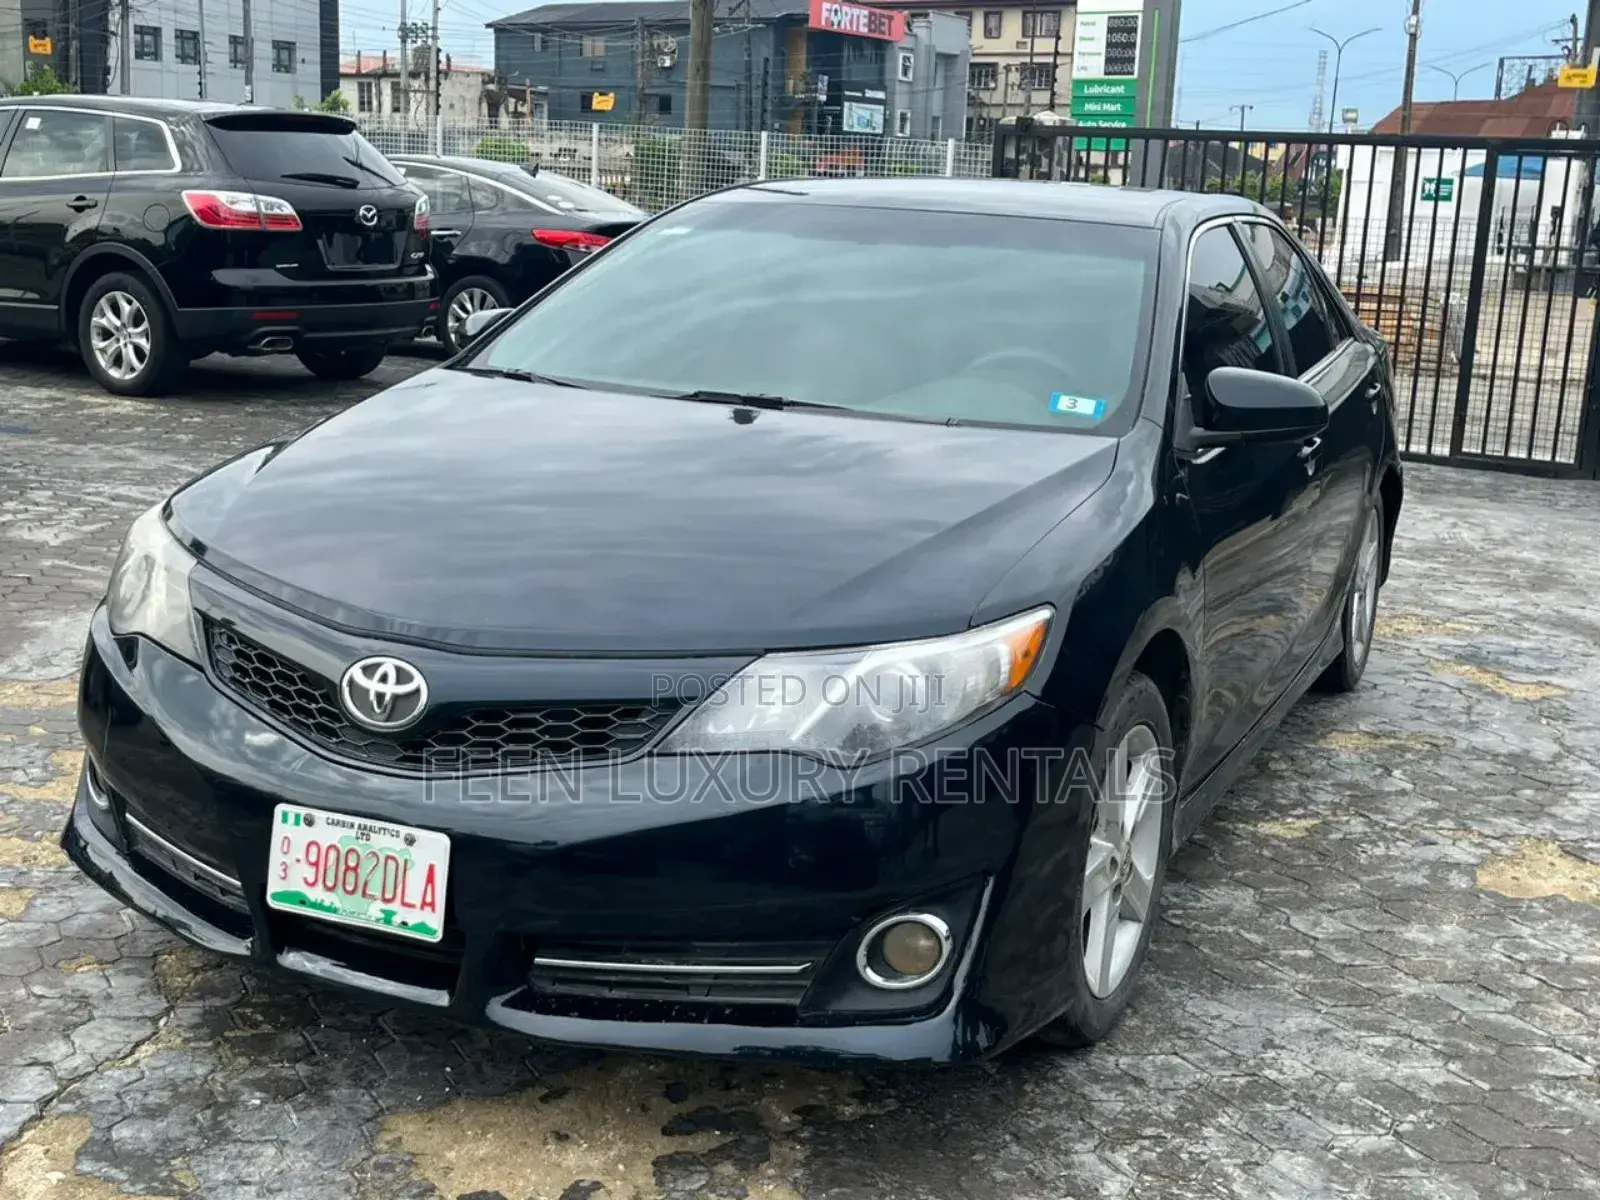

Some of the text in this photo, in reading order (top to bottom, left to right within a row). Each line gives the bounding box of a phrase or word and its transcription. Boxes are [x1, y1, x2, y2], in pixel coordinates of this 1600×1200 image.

[821, 1, 894, 36] FORTEBET
[1083, 84, 1125, 94] Lubricant
[1084, 102, 1122, 111] Mini Mart
[1066, 398, 1078, 410] 3
[356, 822, 400, 838] ANALYTICS
[355, 831, 371, 842] LTD
